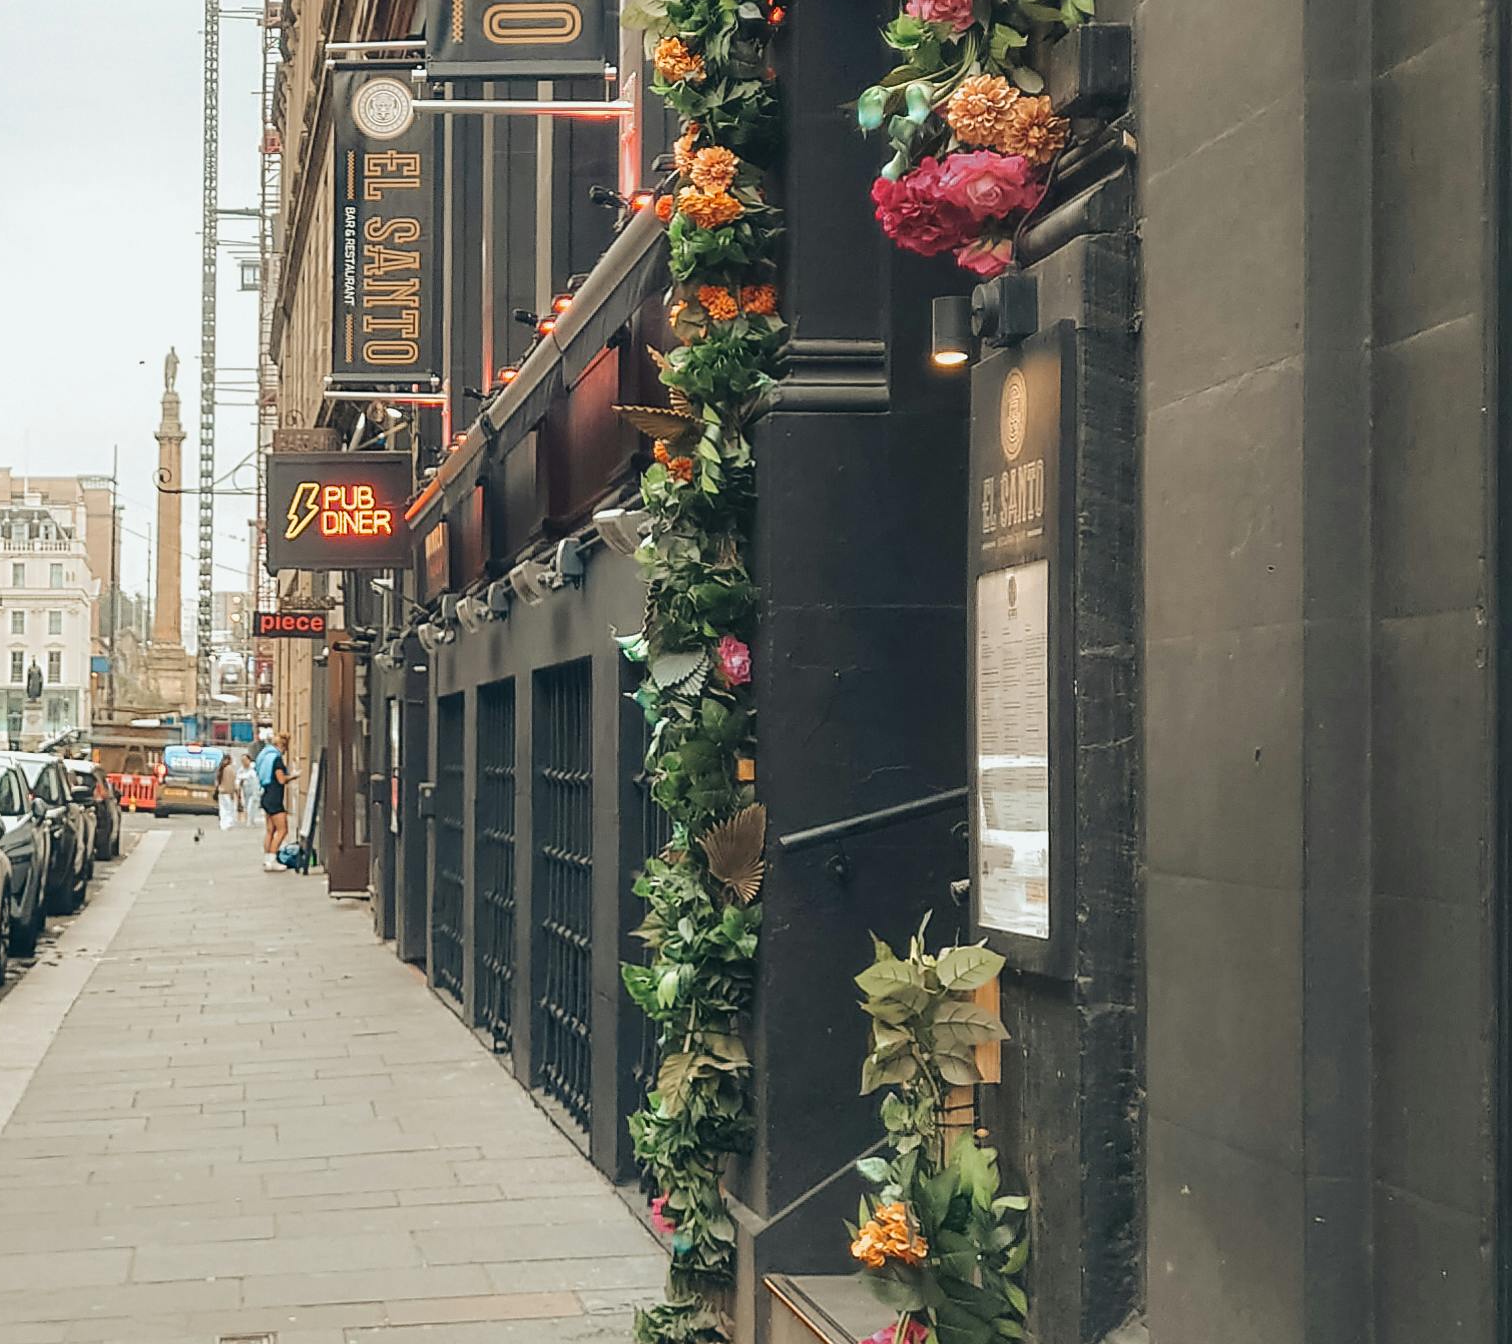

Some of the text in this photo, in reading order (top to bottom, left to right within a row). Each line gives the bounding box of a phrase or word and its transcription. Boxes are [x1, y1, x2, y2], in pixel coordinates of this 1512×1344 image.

[345, 207, 356, 228] BAR
[363, 150, 421, 364] EL SANTO
[344, 238, 356, 306] RESTAURANT
[323, 486, 375, 510] PUB
[982, 459, 1045, 534] EL SANTO
[321, 510, 392, 535] DINER
[260, 612, 325, 633] piece
